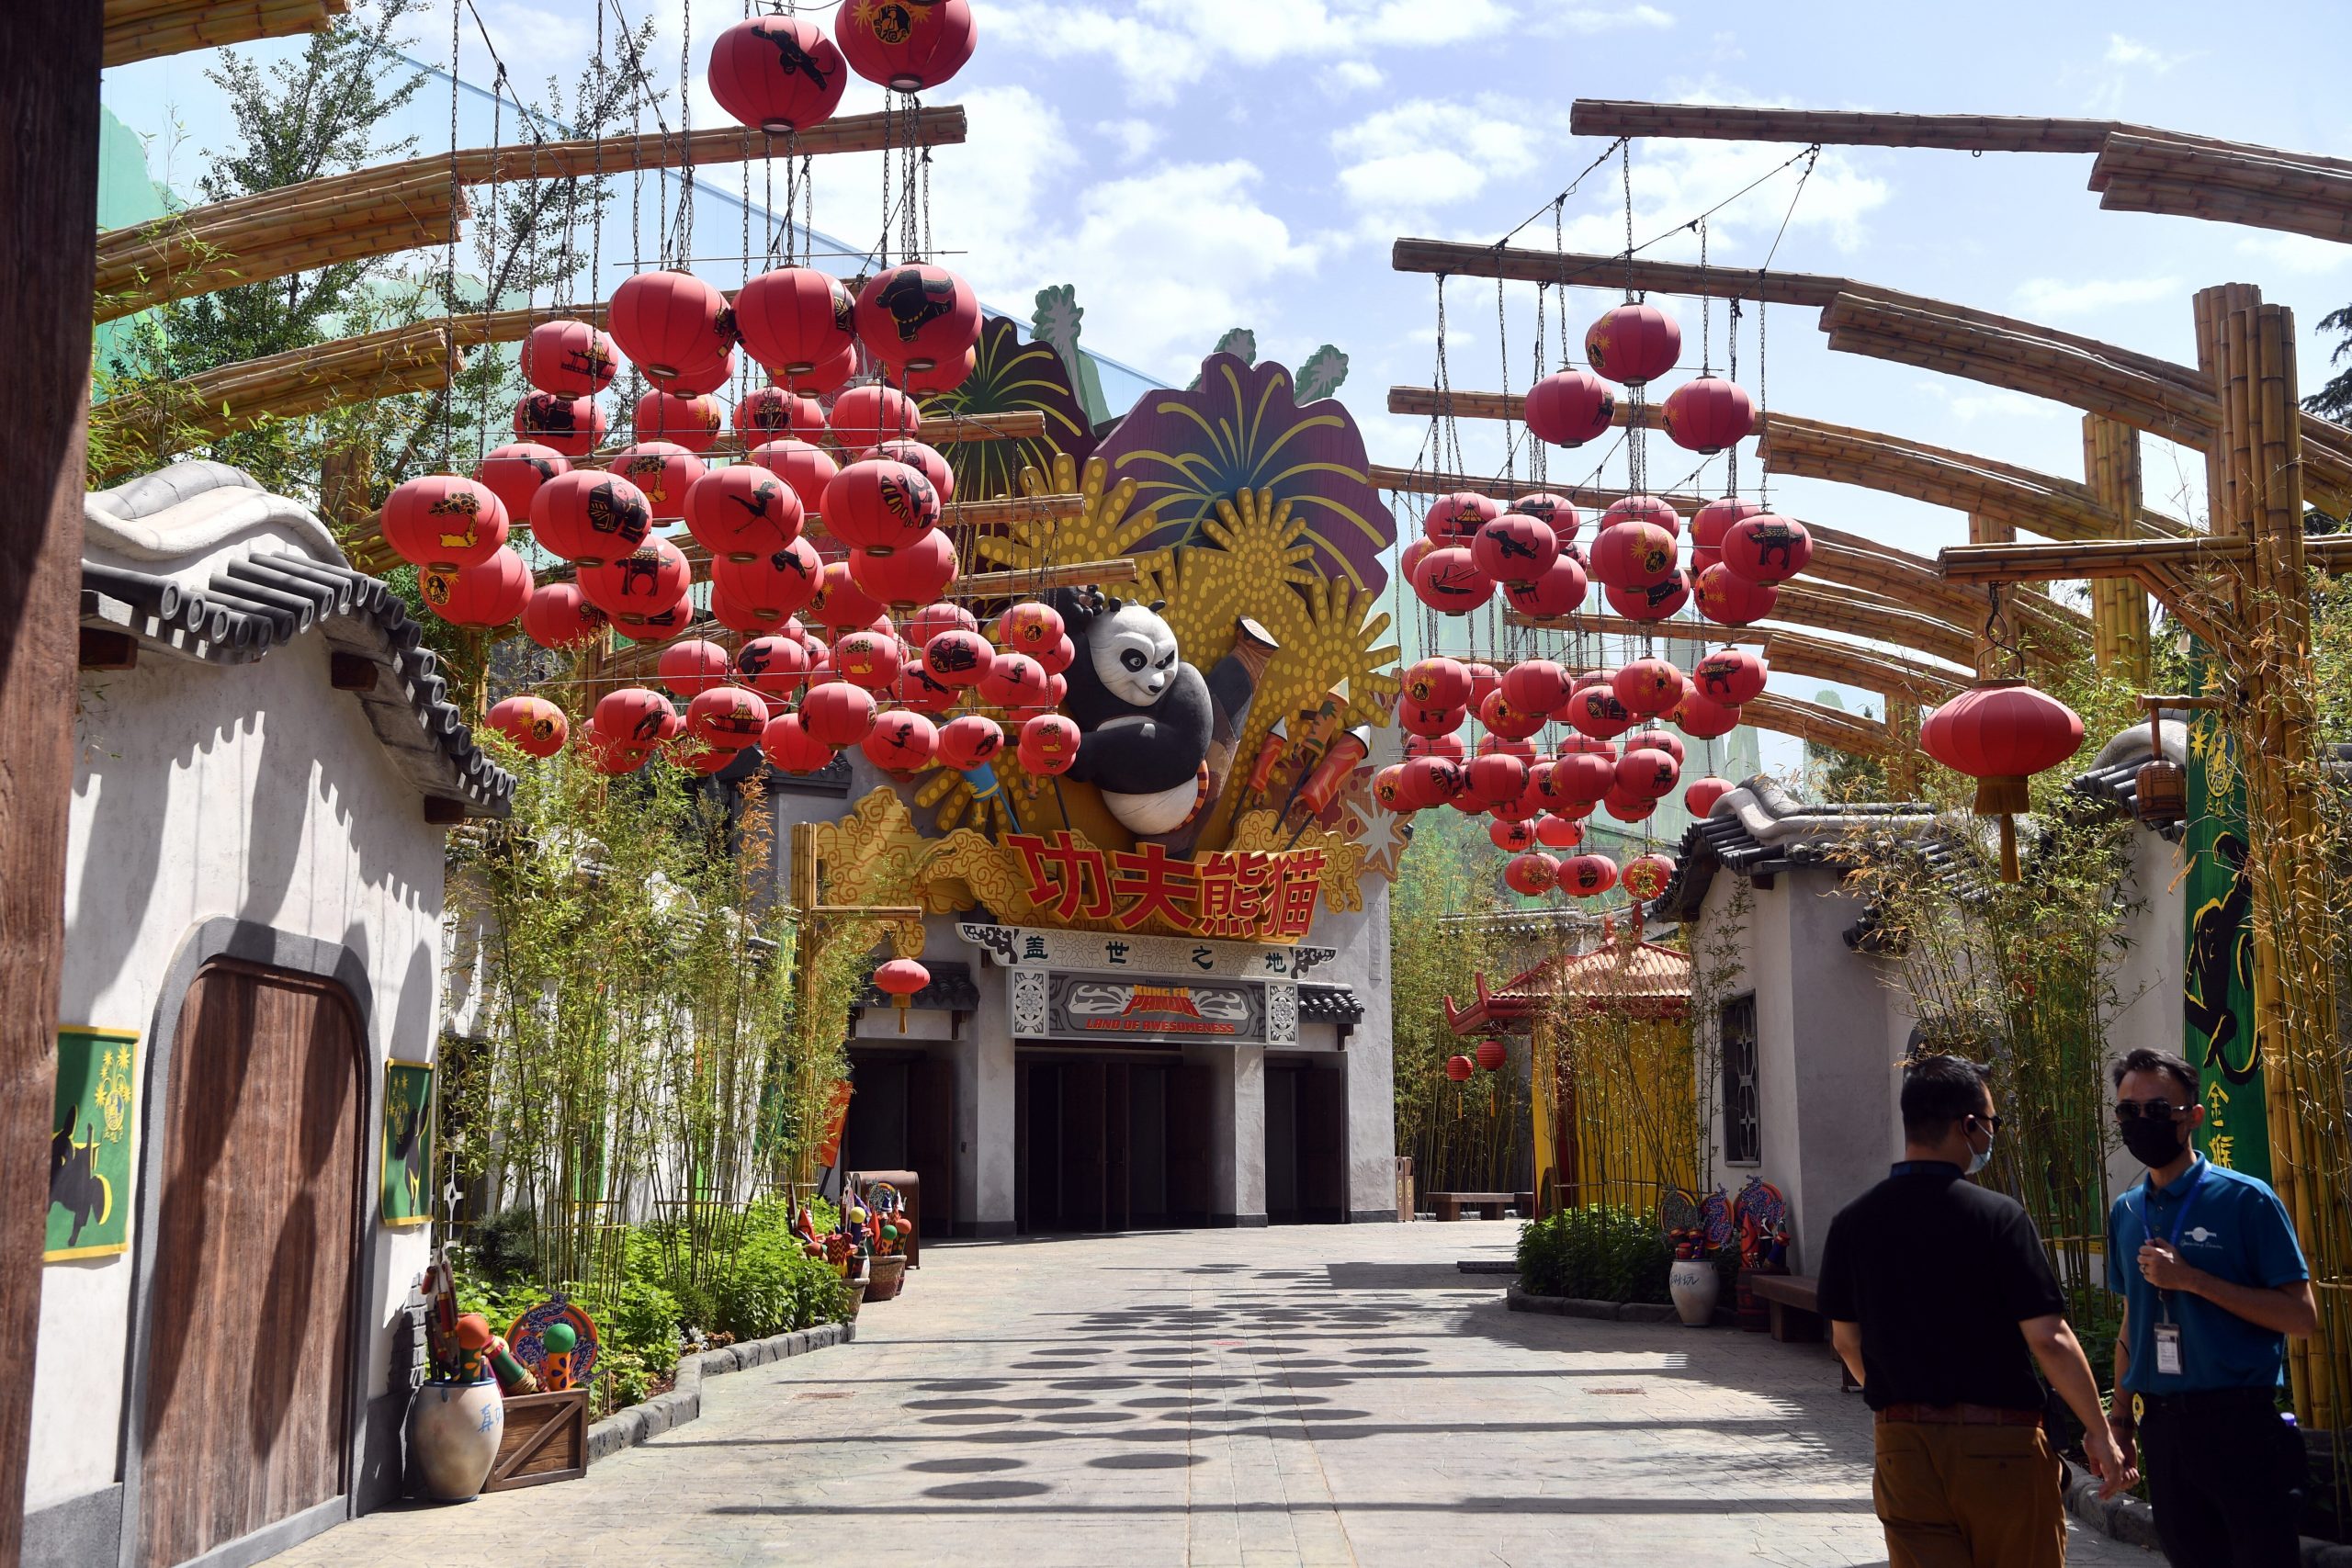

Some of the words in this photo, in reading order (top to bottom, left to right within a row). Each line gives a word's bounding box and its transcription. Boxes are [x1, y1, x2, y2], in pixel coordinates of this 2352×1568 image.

[1003, 829, 1327, 938] 功夫熊猫
[1023, 936, 1287, 974] 盖世之地
[1134, 985, 1170, 996] KUNG
[1173, 987, 1190, 998] FU
[1121, 996, 1202, 1019] PANDA
[1085, 1019, 1120, 1030] LAND
[1124, 1020, 1139, 1031] OF
[1142, 1021, 1235, 1034] AWESOMENESS
